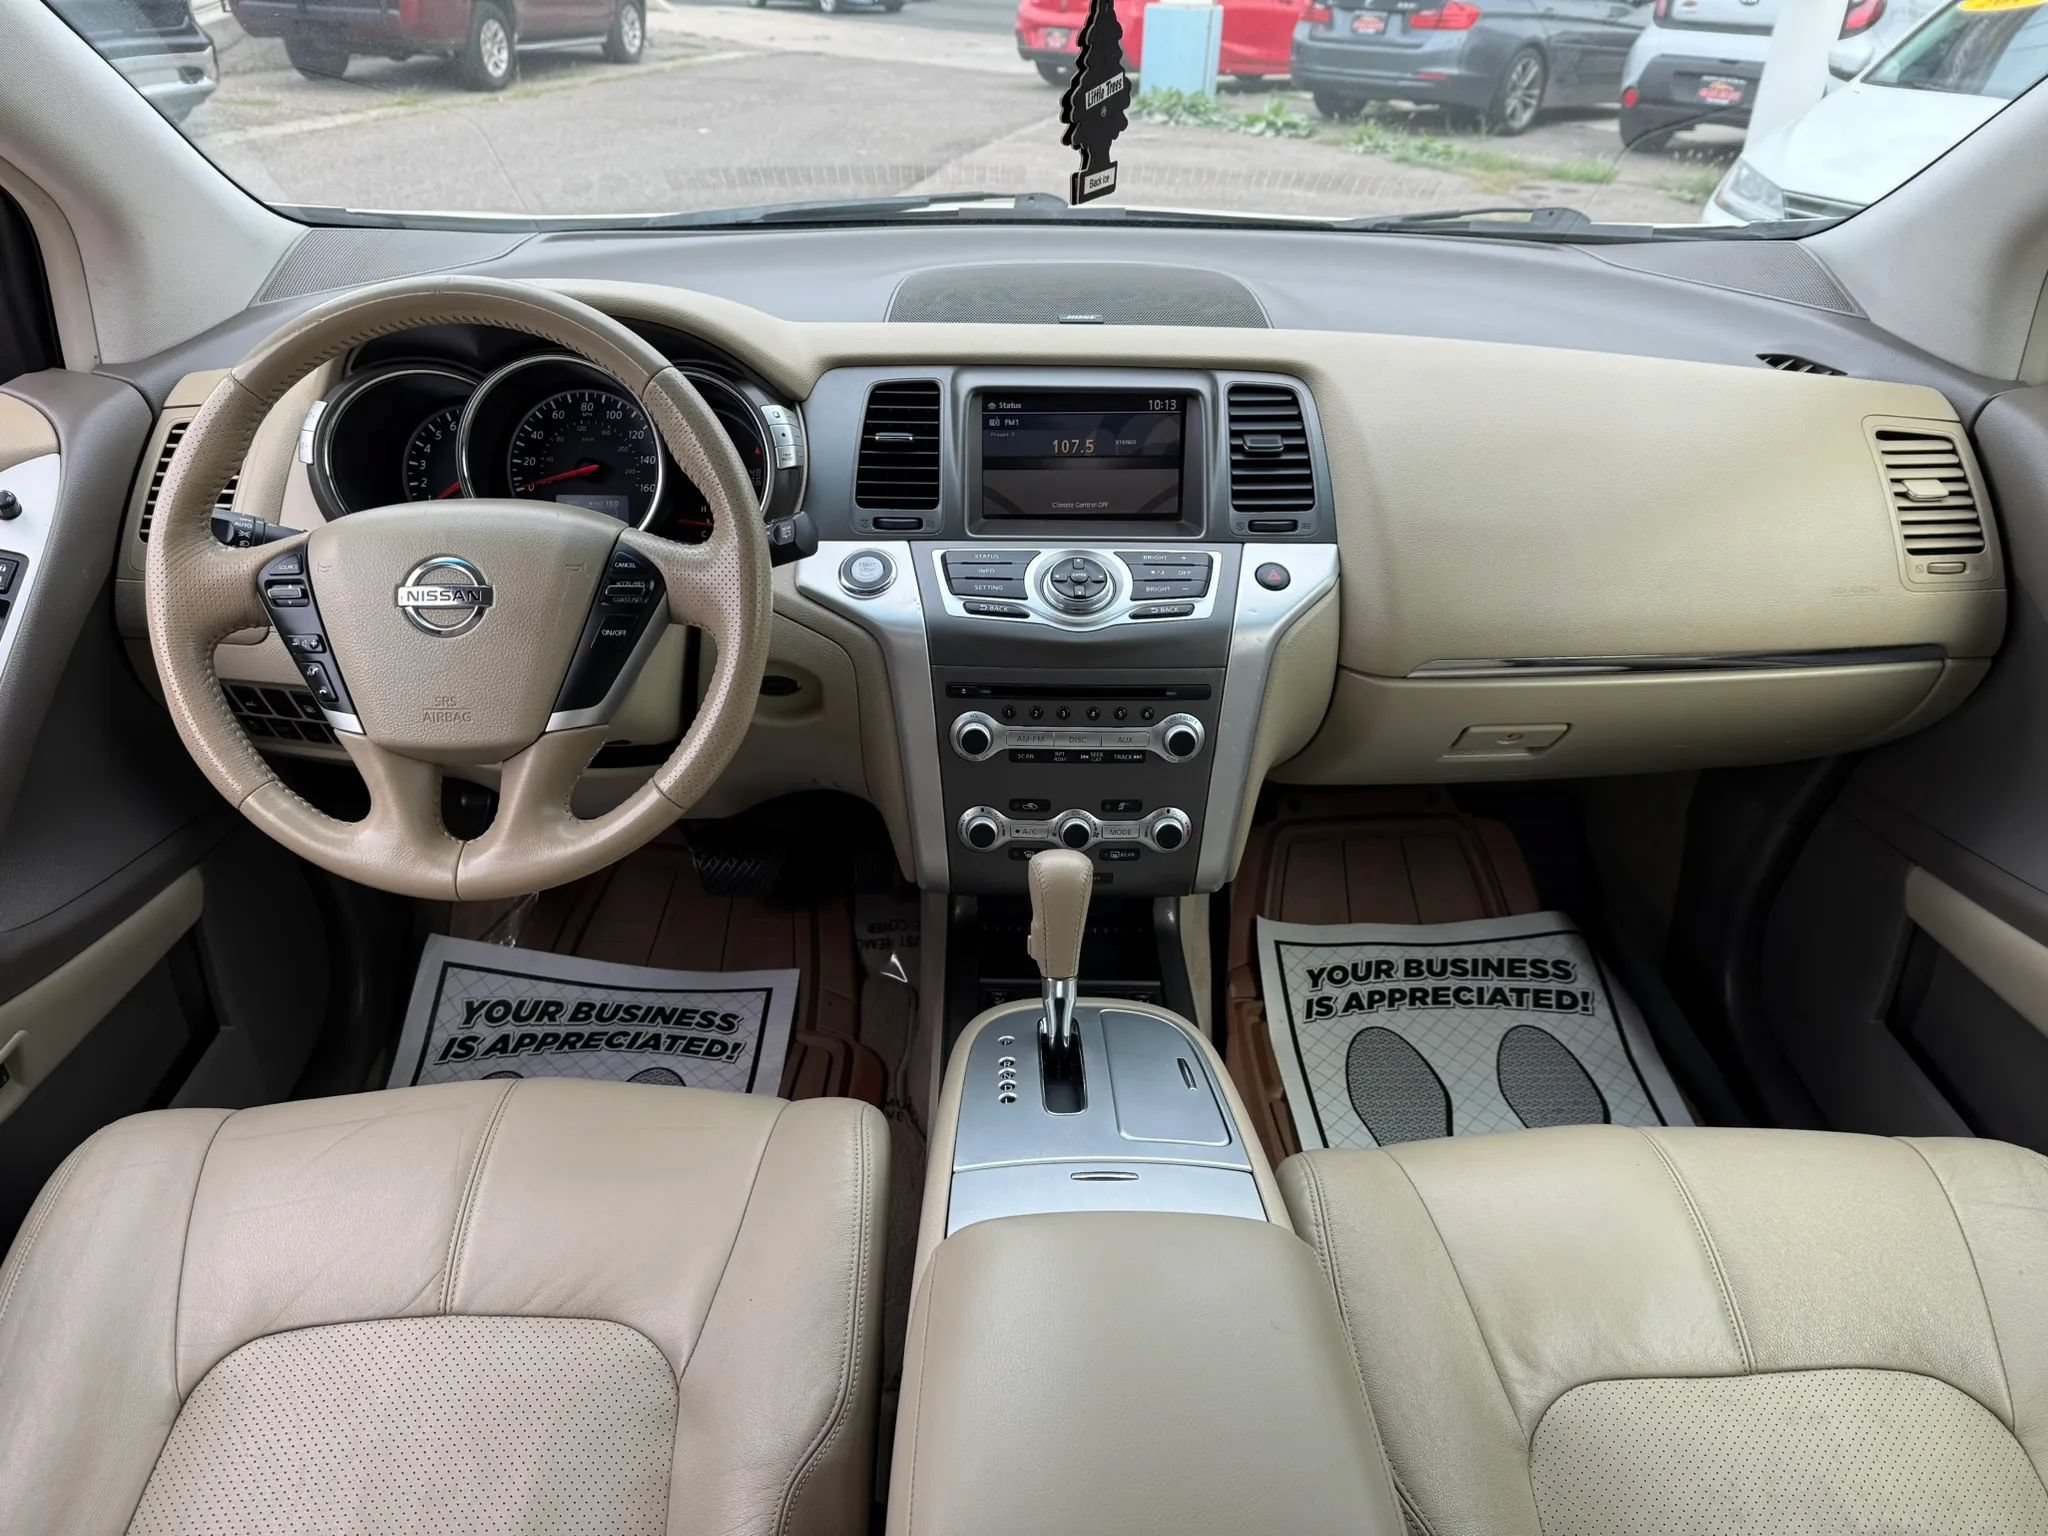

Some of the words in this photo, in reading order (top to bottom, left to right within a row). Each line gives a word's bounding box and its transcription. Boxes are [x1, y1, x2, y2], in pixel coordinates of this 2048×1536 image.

[1088, 86, 1105, 108] Little
[1106, 78, 1122, 97] Trees
[581, 403, 594, 411] 80
[1148, 400, 1177, 411] 10:13
[552, 411, 565, 420] 60
[606, 411, 623, 420] 100
[450, 422, 457, 431] 6
[435, 431, 442, 440] 5
[531, 431, 544, 440] 40
[629, 431, 645, 440] 120
[424, 444, 431, 453] 4
[1052, 439, 1096, 454] 107.5
[523, 457, 536, 466] 20
[640, 456, 656, 464] 140
[420, 461, 426, 470] 3
[421, 478, 428, 488] 2
[640, 484, 656, 493] 160
[406, 590, 483, 603] NISSAN
[434, 696, 458, 707] SRS
[422, 711, 472, 723] AIRBAG
[1306, 959, 1396, 988] YOUR
[1403, 957, 1573, 982] BUSINESS
[1304, 995, 1335, 1020] IS
[1342, 985, 1591, 1013] APPRECIATED!
[461, 999, 565, 1027] YOUR
[567, 1001, 741, 1032] BUSINESS
[437, 1035, 480, 1061] IS
[482, 1031, 743, 1060] APPRECIATED!
